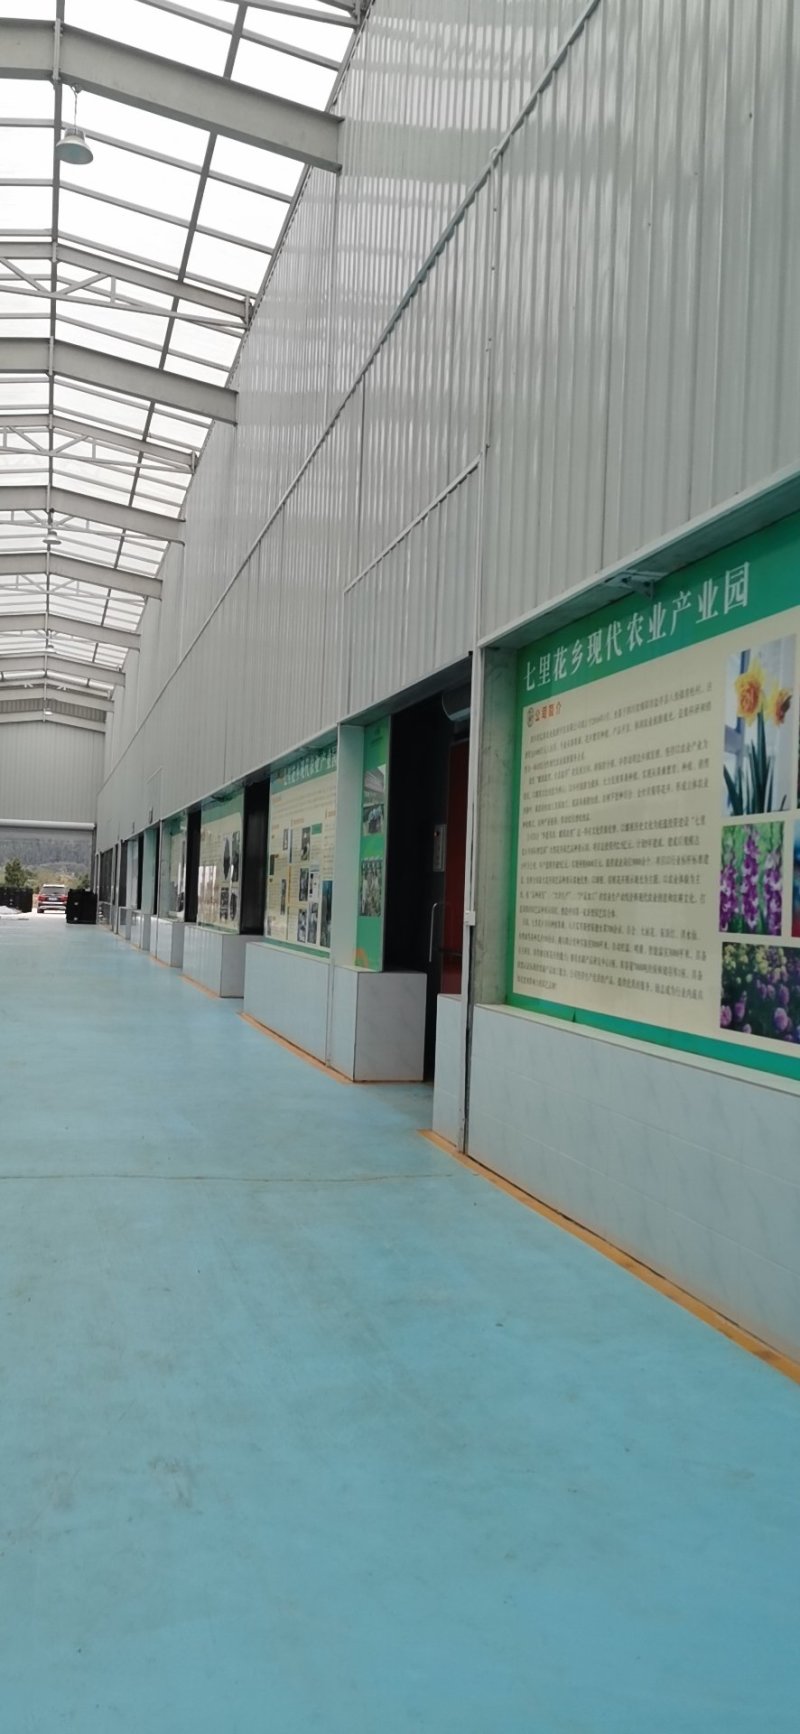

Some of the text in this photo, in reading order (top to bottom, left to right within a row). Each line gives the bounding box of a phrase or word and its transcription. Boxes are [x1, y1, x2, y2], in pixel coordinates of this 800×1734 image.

[523, 562, 750, 691] 七里花乡现代农业产业园
